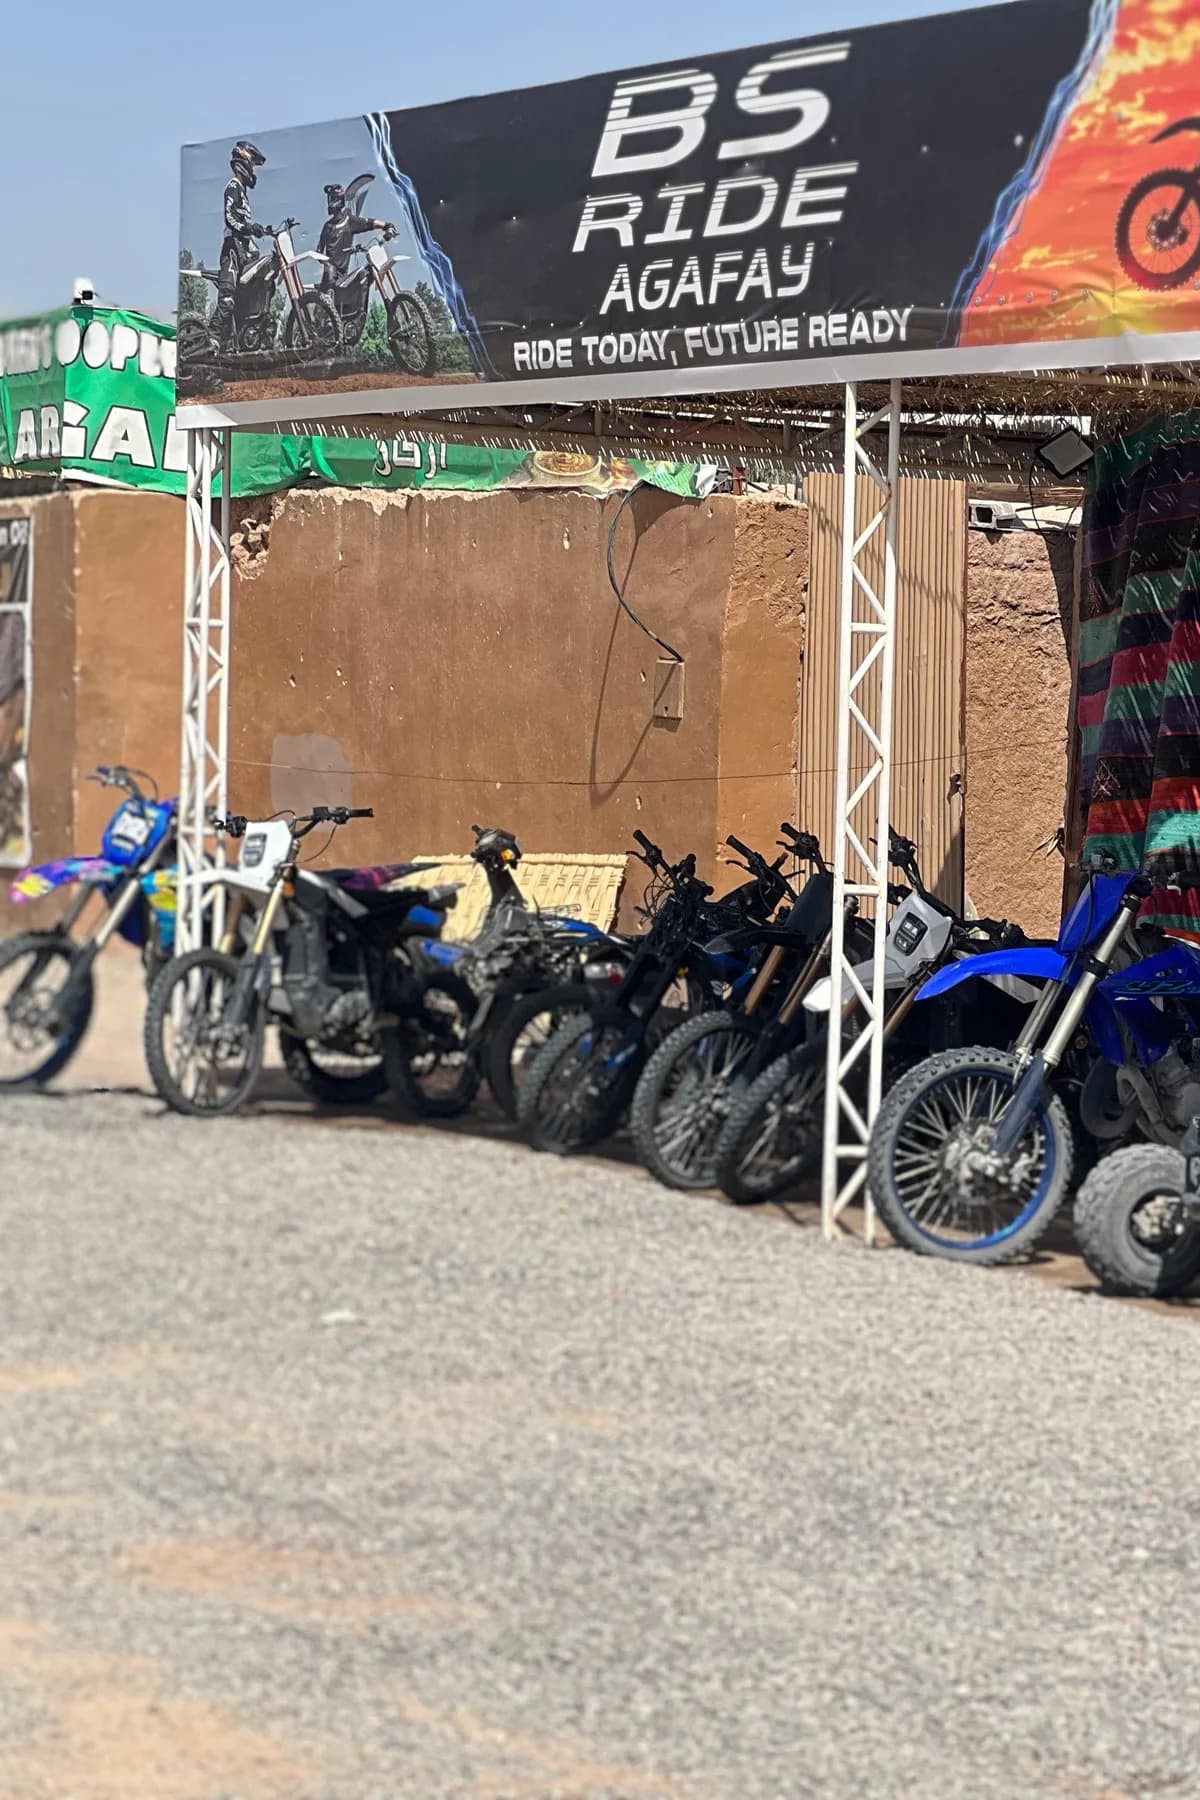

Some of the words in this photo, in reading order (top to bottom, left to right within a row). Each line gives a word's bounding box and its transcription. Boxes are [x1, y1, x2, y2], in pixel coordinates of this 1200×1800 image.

[591, 41, 851, 177] BS
[572, 161, 859, 253] RIDE
[600, 242, 815, 315] AGAFAY
[513, 338, 574, 372] RIDE
[581, 328, 679, 367] TODAY,
[684, 318, 799, 359] FUTURE
[808, 308, 912, 349] READY
